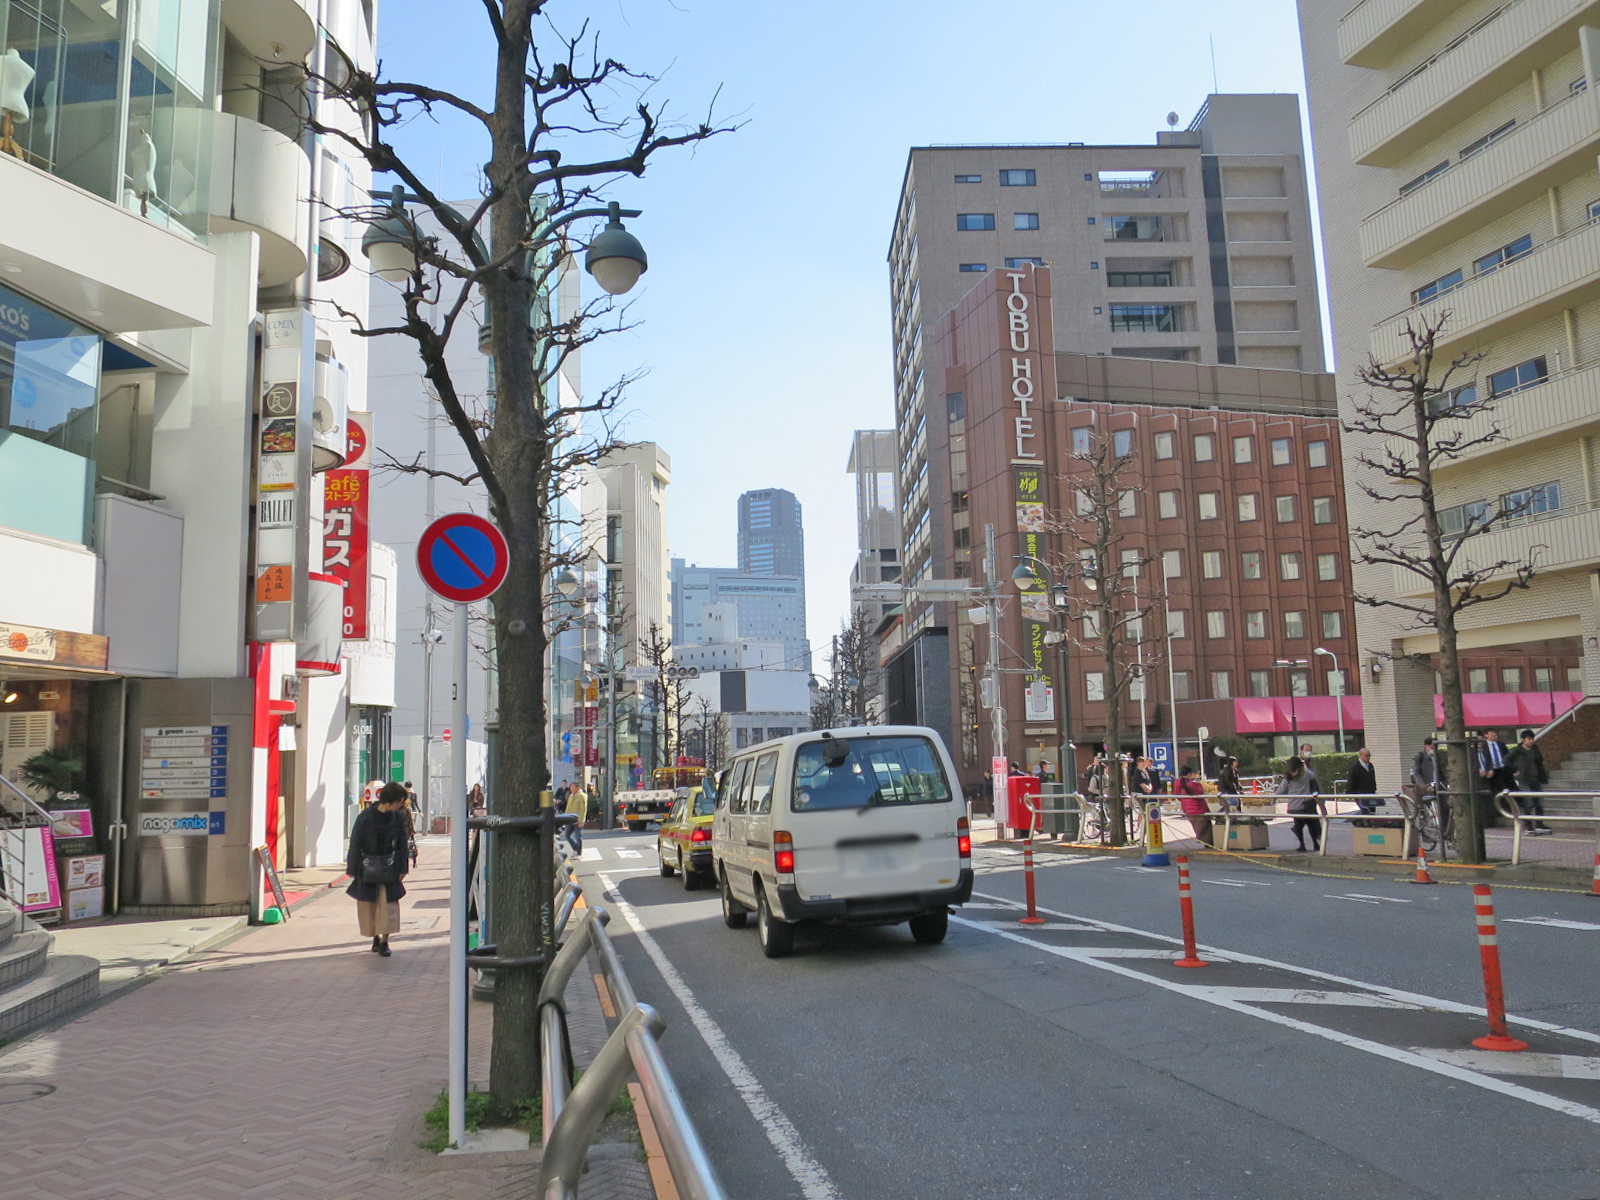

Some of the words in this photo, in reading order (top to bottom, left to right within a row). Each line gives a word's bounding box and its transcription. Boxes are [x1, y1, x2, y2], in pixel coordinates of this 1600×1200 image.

[1006, 272, 1029, 352] TOBU
[1011, 357, 1036, 458] HOTEL
[260, 499, 293, 523] BALLET
[325, 491, 360, 501] ストラン
[1032, 624, 1043, 671] ランチセット
[1156, 748, 1165, 758] P
